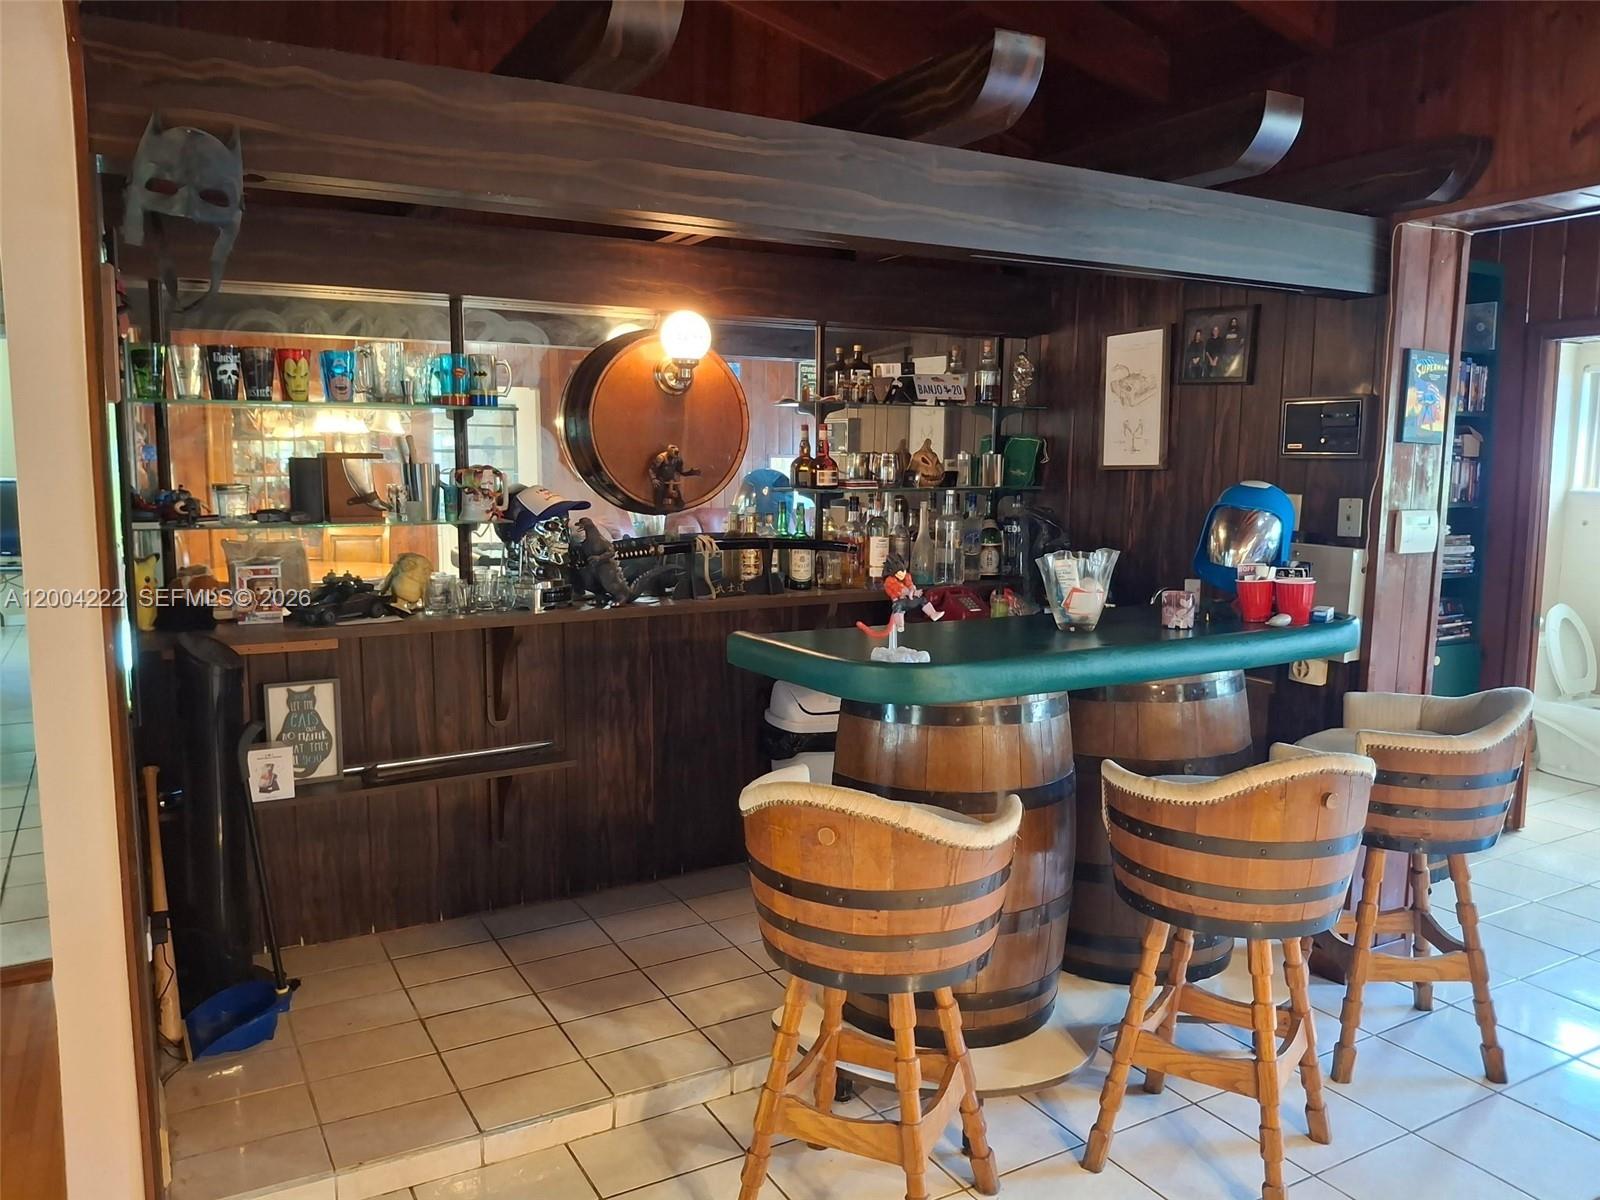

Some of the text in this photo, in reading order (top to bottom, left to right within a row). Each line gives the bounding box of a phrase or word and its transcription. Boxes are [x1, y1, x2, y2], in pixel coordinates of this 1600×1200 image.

[1416, 362, 1447, 378] SUPERMAN
[917, 384, 963, 396] BANJO 20
[290, 711, 319, 728] CATS
[282, 731, 296, 742] NO
[309, 741, 329, 753] THEY
